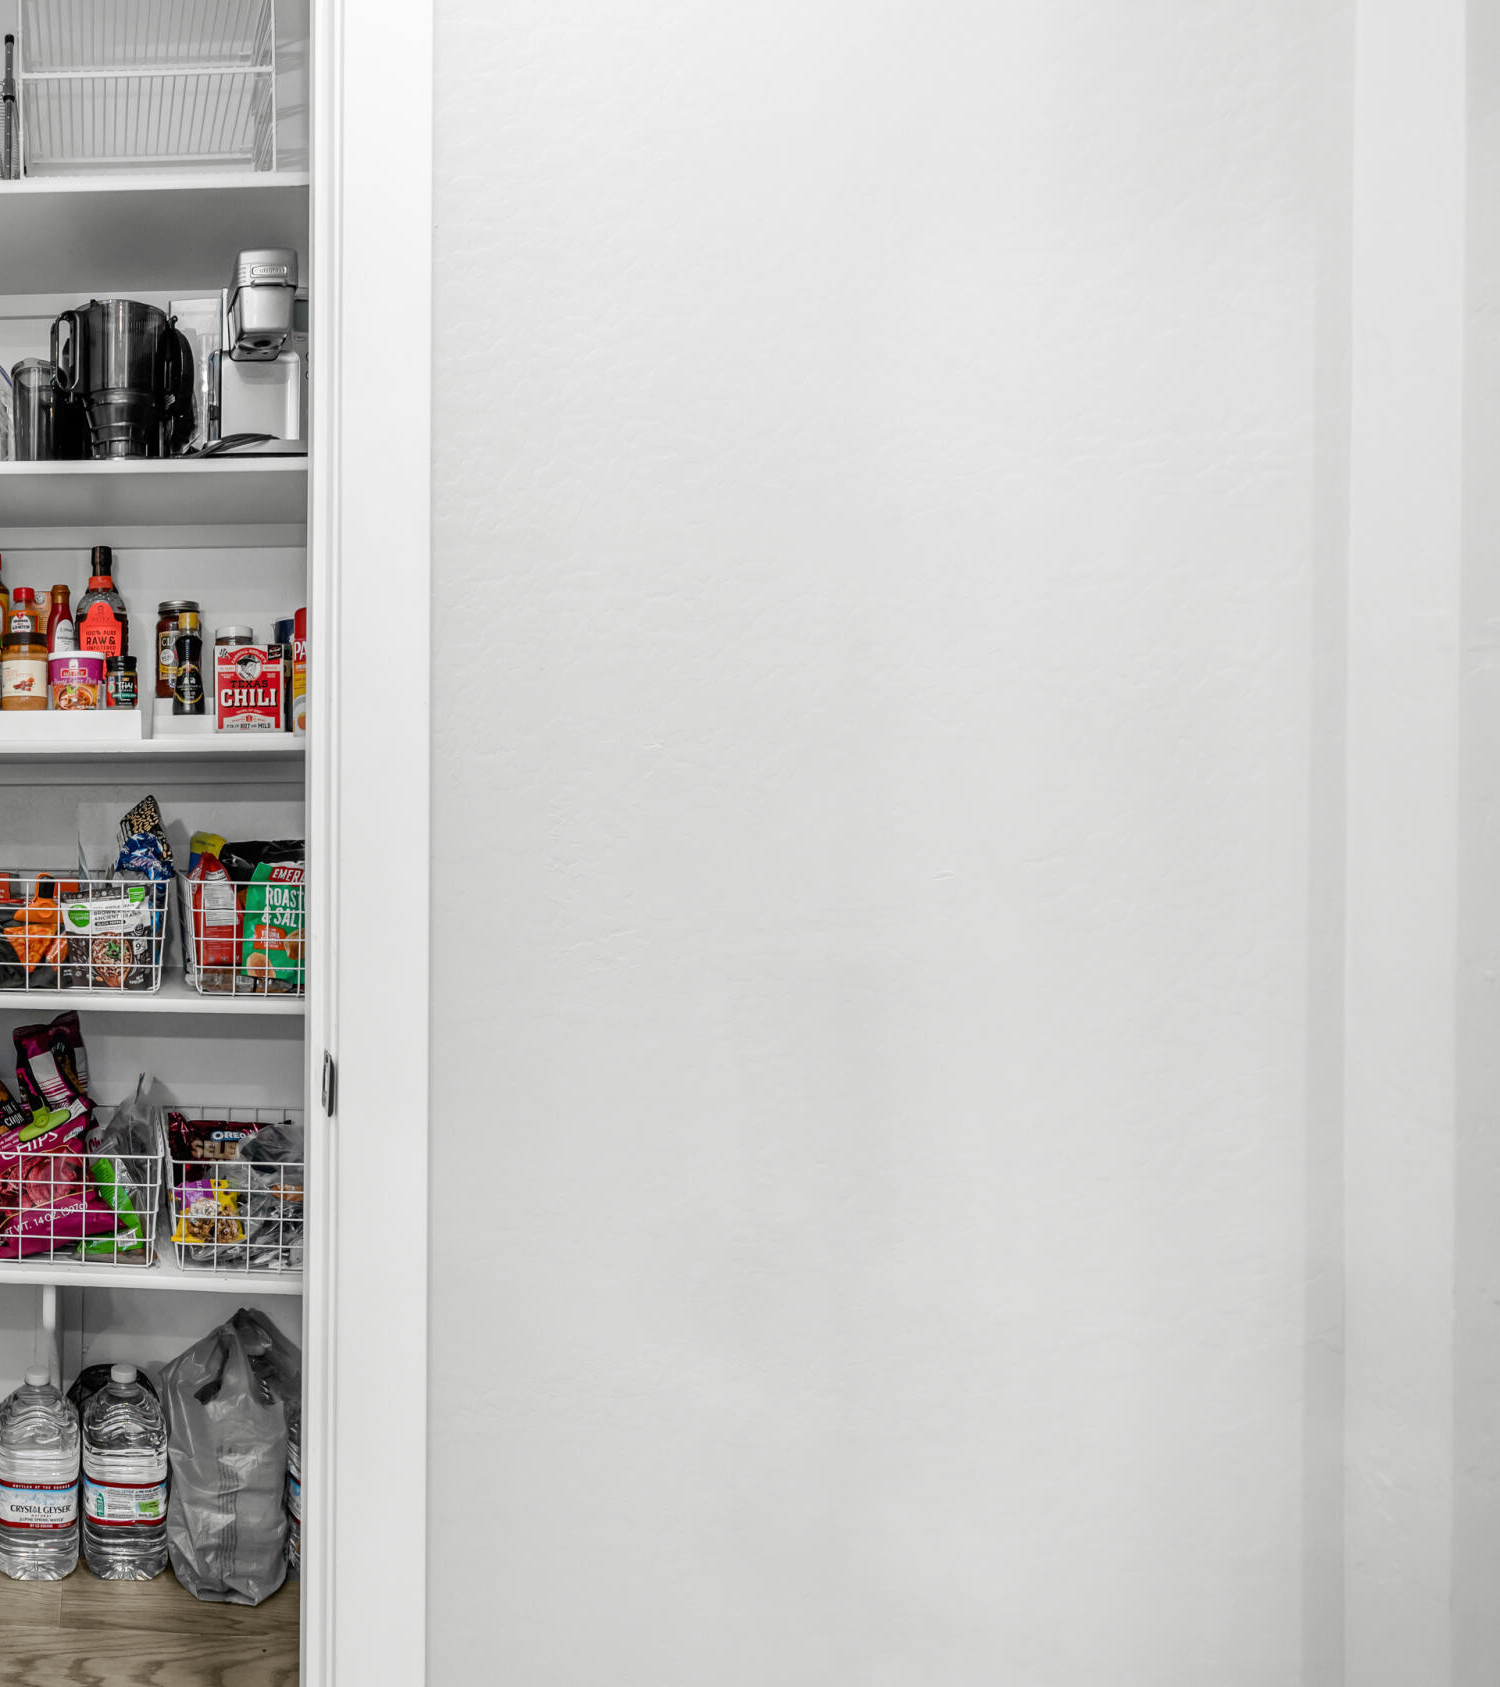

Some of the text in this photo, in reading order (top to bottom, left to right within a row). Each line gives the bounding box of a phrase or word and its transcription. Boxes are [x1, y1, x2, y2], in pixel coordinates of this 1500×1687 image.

[86, 636, 116, 645] RAW &
[294, 641, 306, 660] PA
[230, 680, 269, 688] TEXAS
[221, 688, 277, 707] CHILI
[266, 887, 304, 908] ROAST
[211, 1130, 247, 1140] OREO
[13, 1220, 33, 1233] WT.
[10, 1504, 71, 1514] CRYSTAL GEYSER
